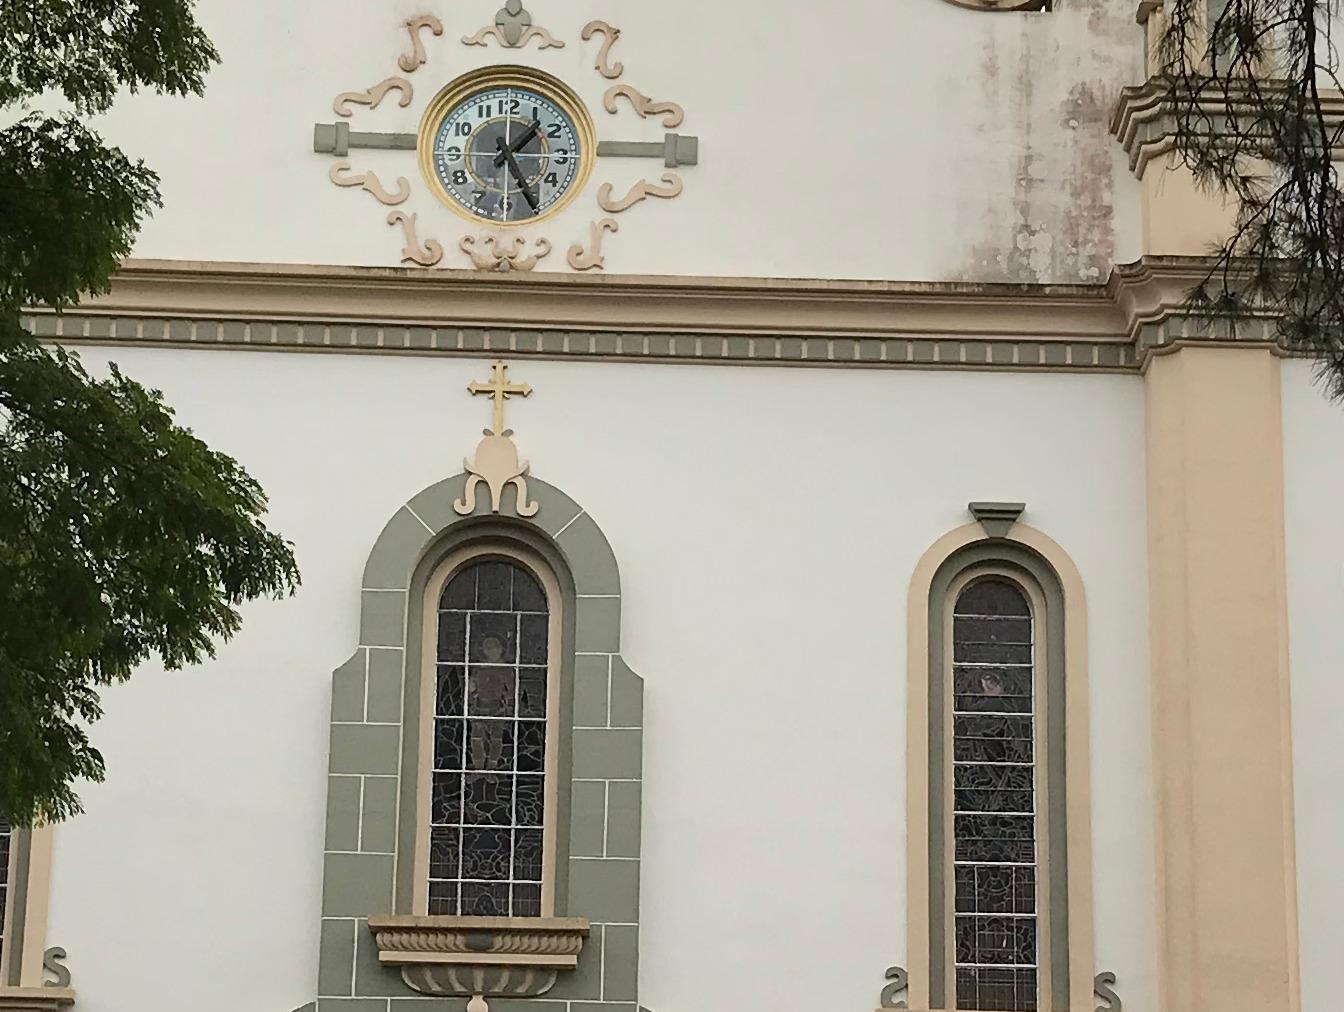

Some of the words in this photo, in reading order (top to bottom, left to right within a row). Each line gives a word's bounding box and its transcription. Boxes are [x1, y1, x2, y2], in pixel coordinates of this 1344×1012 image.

[478, 104, 492, 118] 11
[498, 99, 521, 115] 12
[532, 107, 538, 121] 1
[455, 122, 472, 137] 10
[546, 123, 562, 139] 2
[447, 146, 461, 162] 9
[554, 148, 569, 165] 3
[452, 170, 468, 186] 8
[544, 172, 558, 187] 4
